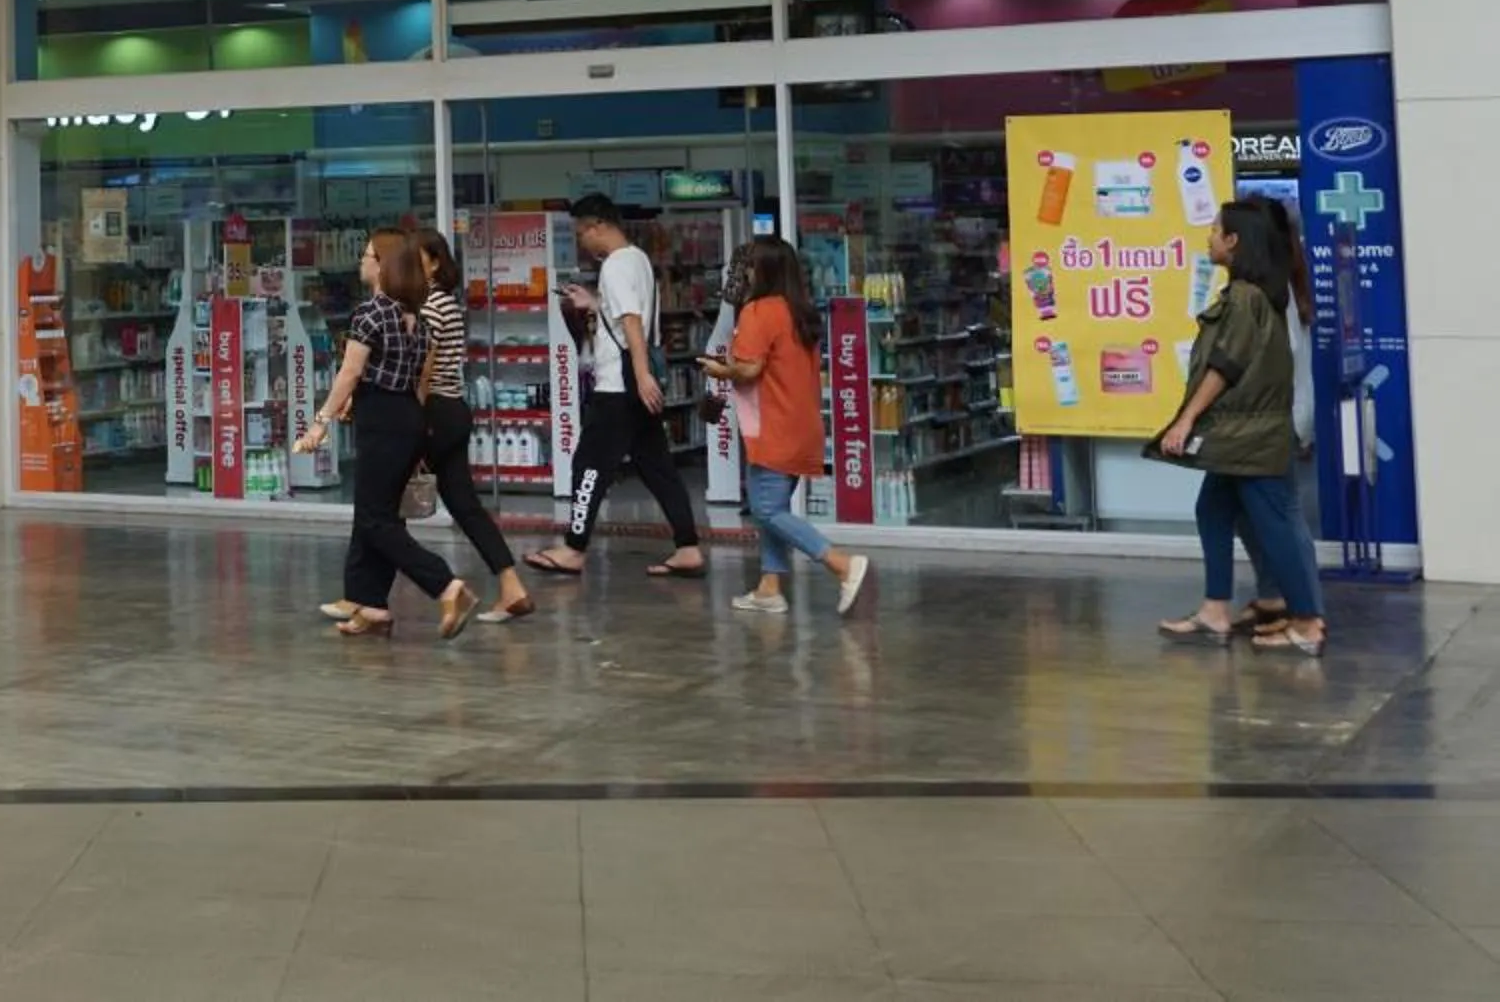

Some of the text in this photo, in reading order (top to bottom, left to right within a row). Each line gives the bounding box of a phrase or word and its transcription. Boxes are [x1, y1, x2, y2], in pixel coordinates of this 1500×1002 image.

[1318, 125, 1374, 152] Boots
[1313, 245, 1394, 258] wome
[1089, 276, 1151, 318] ฟรี
[839, 334, 857, 368] buy
[172, 347, 187, 452] special offer
[219, 332, 238, 468] buy 1 get 1 free
[293, 345, 306, 441] special offe
[557, 345, 574, 455] special offer
[840, 388, 860, 420] get
[718, 415, 732, 460] offer
[845, 439, 867, 489] free
[572, 469, 598, 535] adidas
